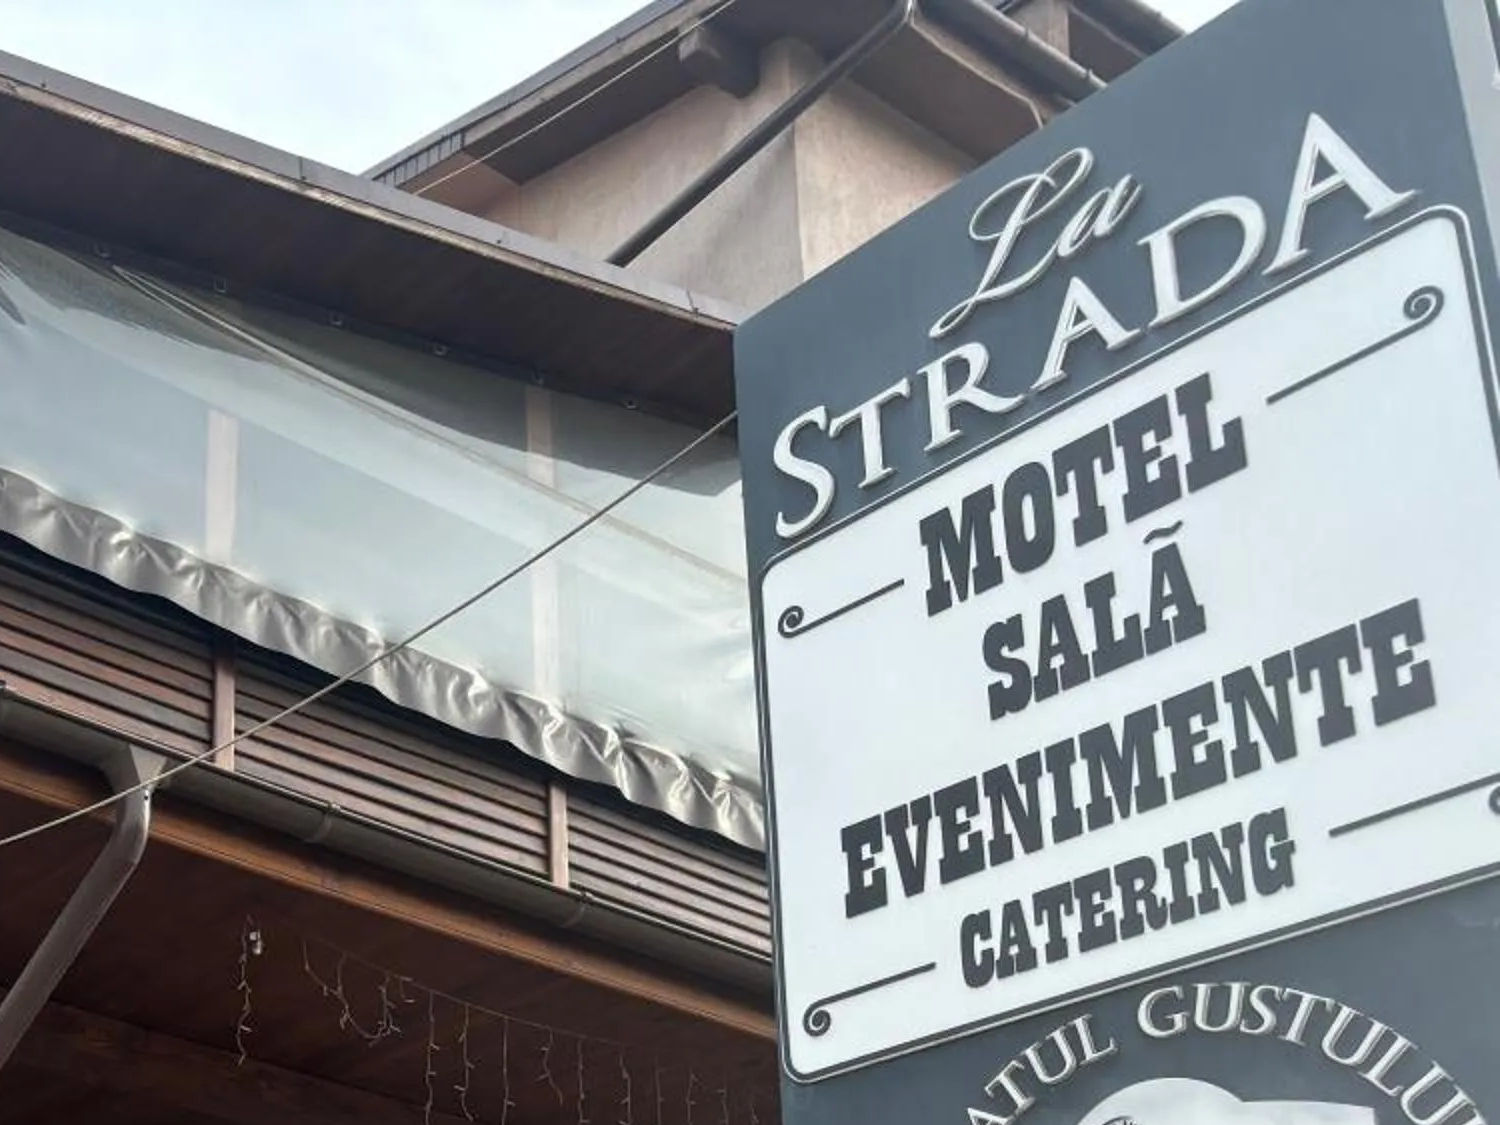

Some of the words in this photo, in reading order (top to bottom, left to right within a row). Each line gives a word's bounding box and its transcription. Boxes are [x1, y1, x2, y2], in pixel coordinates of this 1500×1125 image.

[772, 112, 1424, 539] STRADA
[929, 146, 1142, 338] La
[918, 371, 1248, 618] MOTEL
[839, 597, 1437, 919] EVENIMENTE
[959, 806, 1296, 989] CATERING
